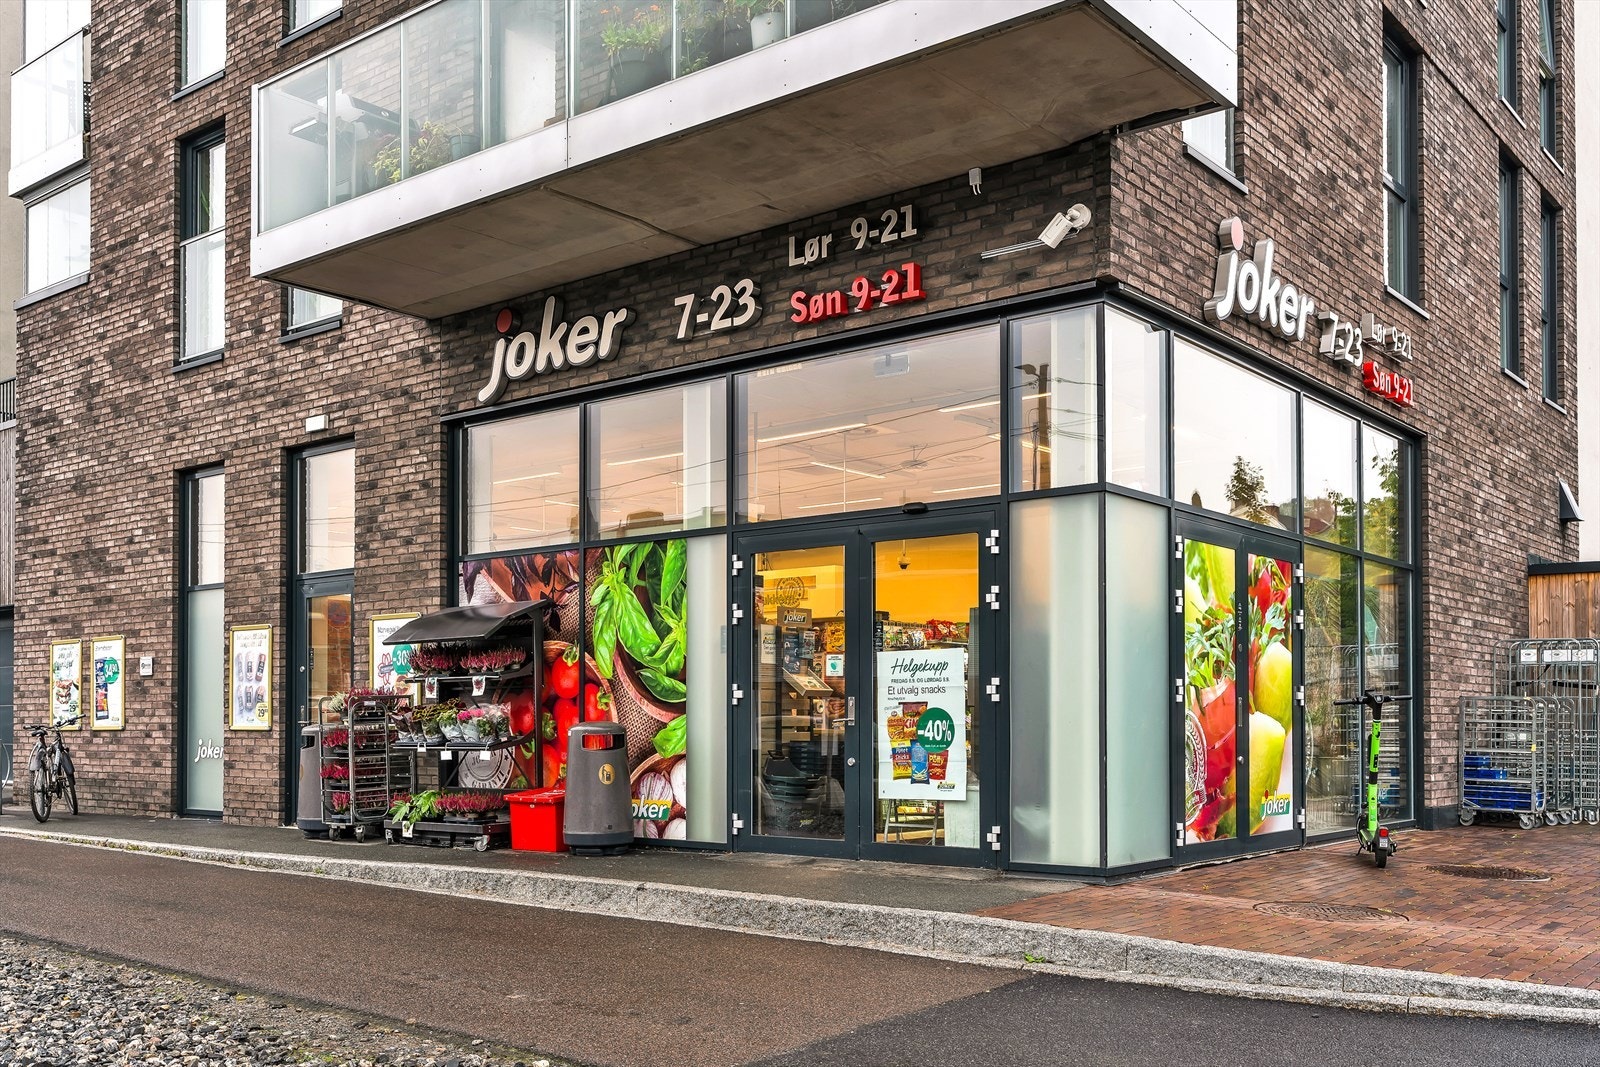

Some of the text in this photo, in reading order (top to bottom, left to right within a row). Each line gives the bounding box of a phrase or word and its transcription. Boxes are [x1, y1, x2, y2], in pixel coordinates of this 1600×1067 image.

[788, 203, 919, 268] Lør 9-21
[789, 261, 922, 324] Søn 9-21
[1209, 215, 1315, 342] joker
[674, 277, 760, 339] 7-23
[477, 295, 630, 404] joker
[1321, 311, 1364, 367] 7-23
[1390, 326, 1413, 361] 9-21
[1369, 361, 1415, 406] Søn 9-21
[784, 609, 806, 624] joker
[890, 657, 949, 678] Helgekupp
[887, 685, 946, 696] Et utvalg snacks
[917, 719, 952, 742] -40%
[632, 794, 668, 819] oker
[1261, 789, 1289, 821] joker
